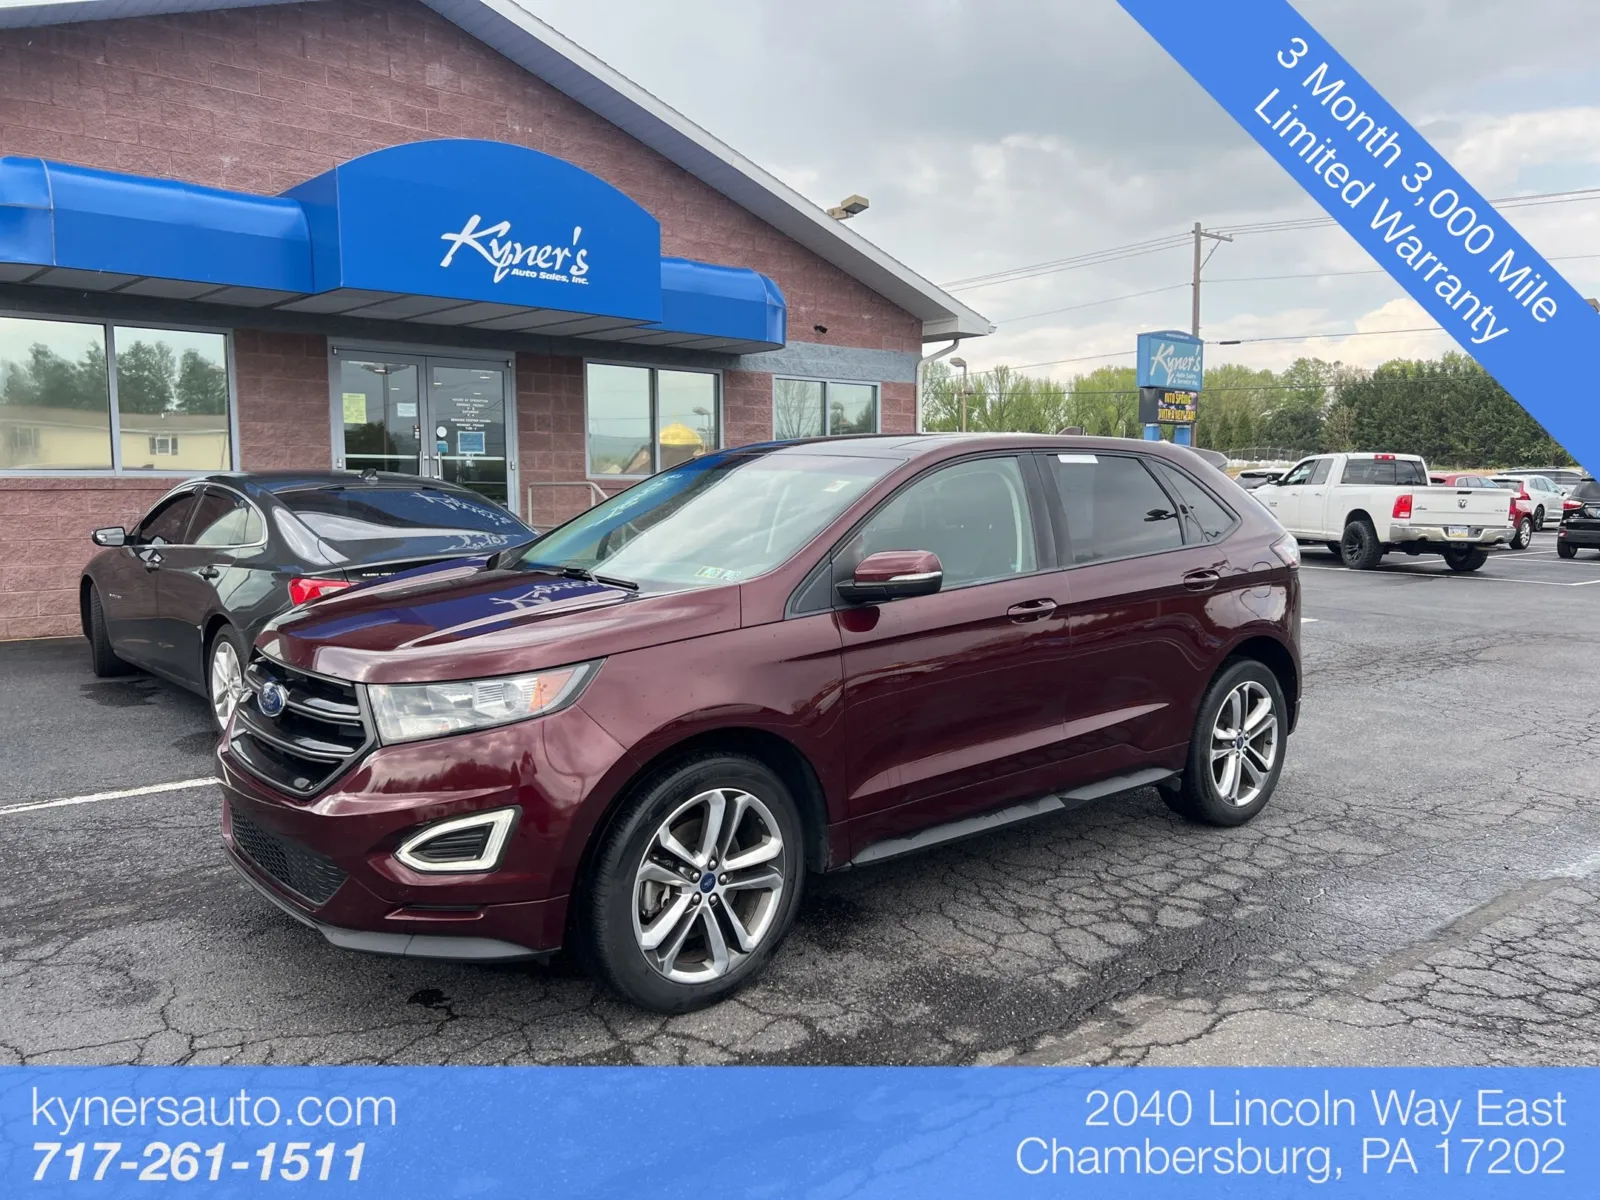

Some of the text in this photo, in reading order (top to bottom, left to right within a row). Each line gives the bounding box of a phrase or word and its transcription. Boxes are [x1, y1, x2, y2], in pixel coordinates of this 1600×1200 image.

[440, 214, 589, 283] Kyner's
[511, 268, 589, 285] Auto Sales, Inc.
[1150, 343, 1201, 386] Kyner's
